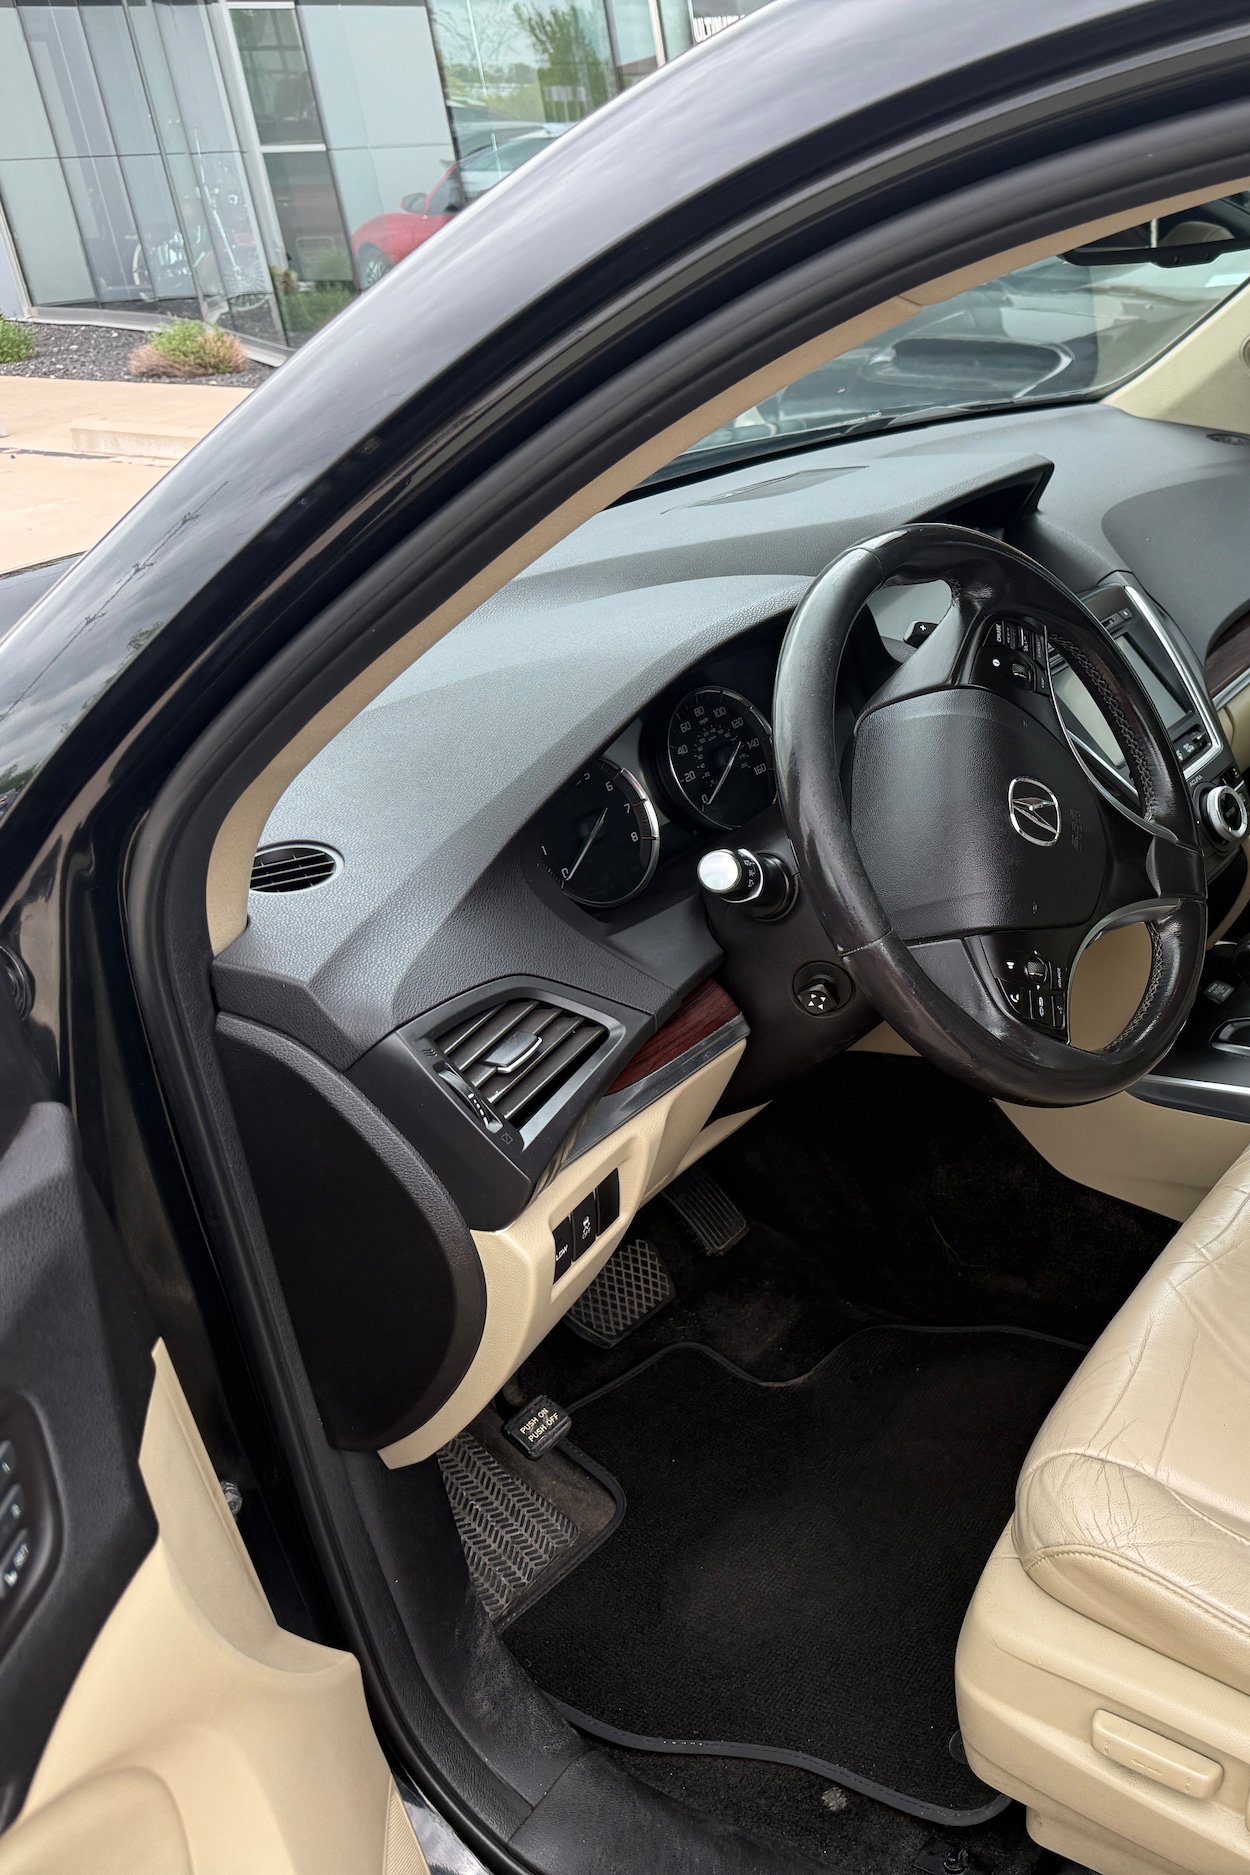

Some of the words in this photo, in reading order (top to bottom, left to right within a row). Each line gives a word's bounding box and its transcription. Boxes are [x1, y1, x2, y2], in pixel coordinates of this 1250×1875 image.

[693, 705, 705, 717] 80
[713, 706, 727, 718] 100
[680, 721, 692, 733] 60
[731, 717, 744, 729] 120
[677, 745, 689, 755] 40
[747, 738, 760, 750] 140
[753, 763, 767, 776] 160
[684, 770, 696, 783] 20
[605, 781, 614, 792] 6
[623, 803, 631, 814] 7
[630, 831, 639, 842] 8
[519, 1416, 539, 1435] PUSH
[537, 1407, 549, 1418] ON
[528, 1424, 548, 1443] PUSH
[546, 1412, 559, 1426] OFF
